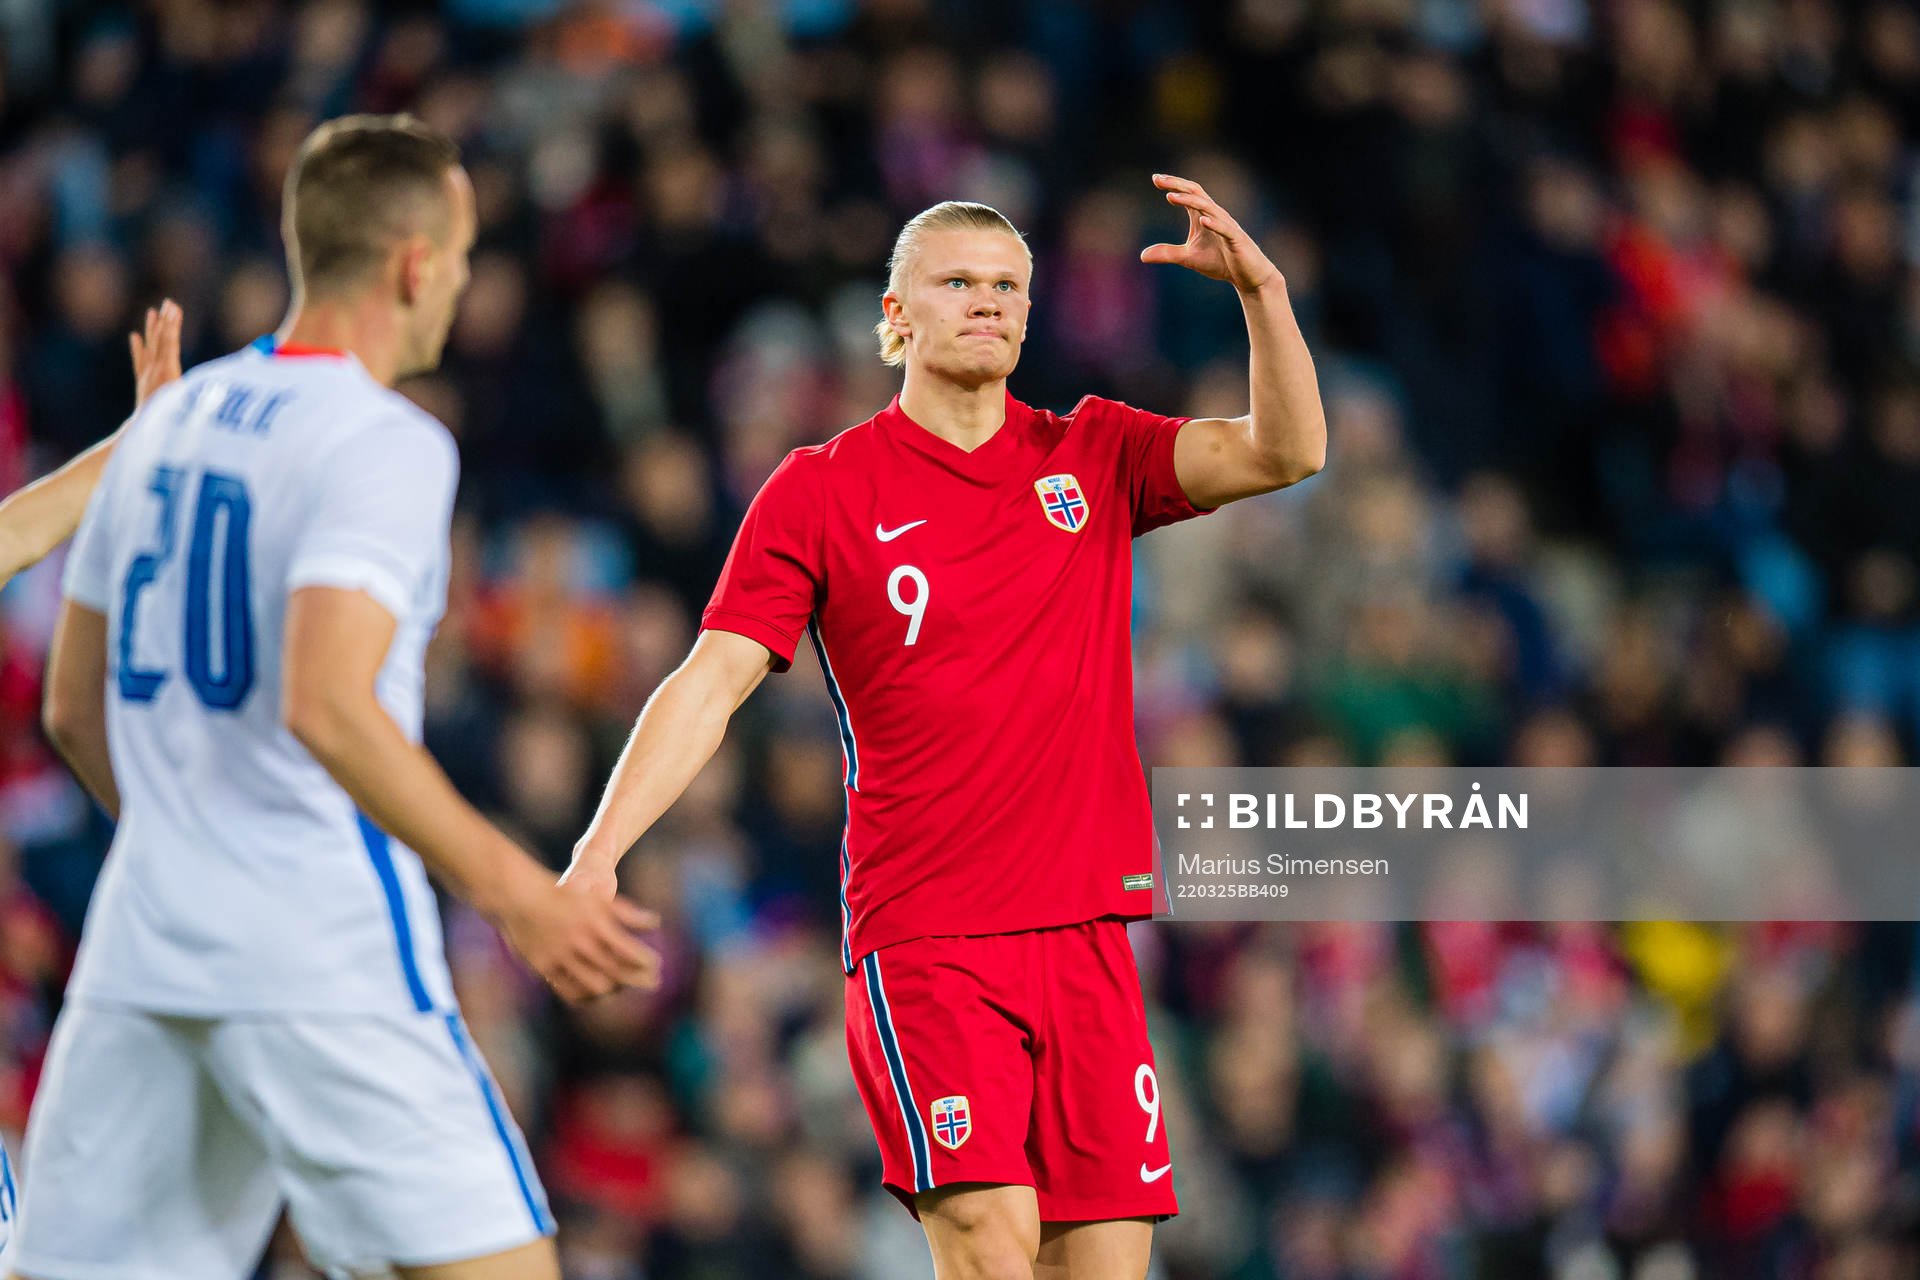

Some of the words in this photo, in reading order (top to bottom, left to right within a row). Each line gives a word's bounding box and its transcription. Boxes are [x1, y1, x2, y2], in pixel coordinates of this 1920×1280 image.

[118, 466, 255, 710] 20
[887, 564, 930, 646] 9
[1134, 1063, 1160, 1143] 9
